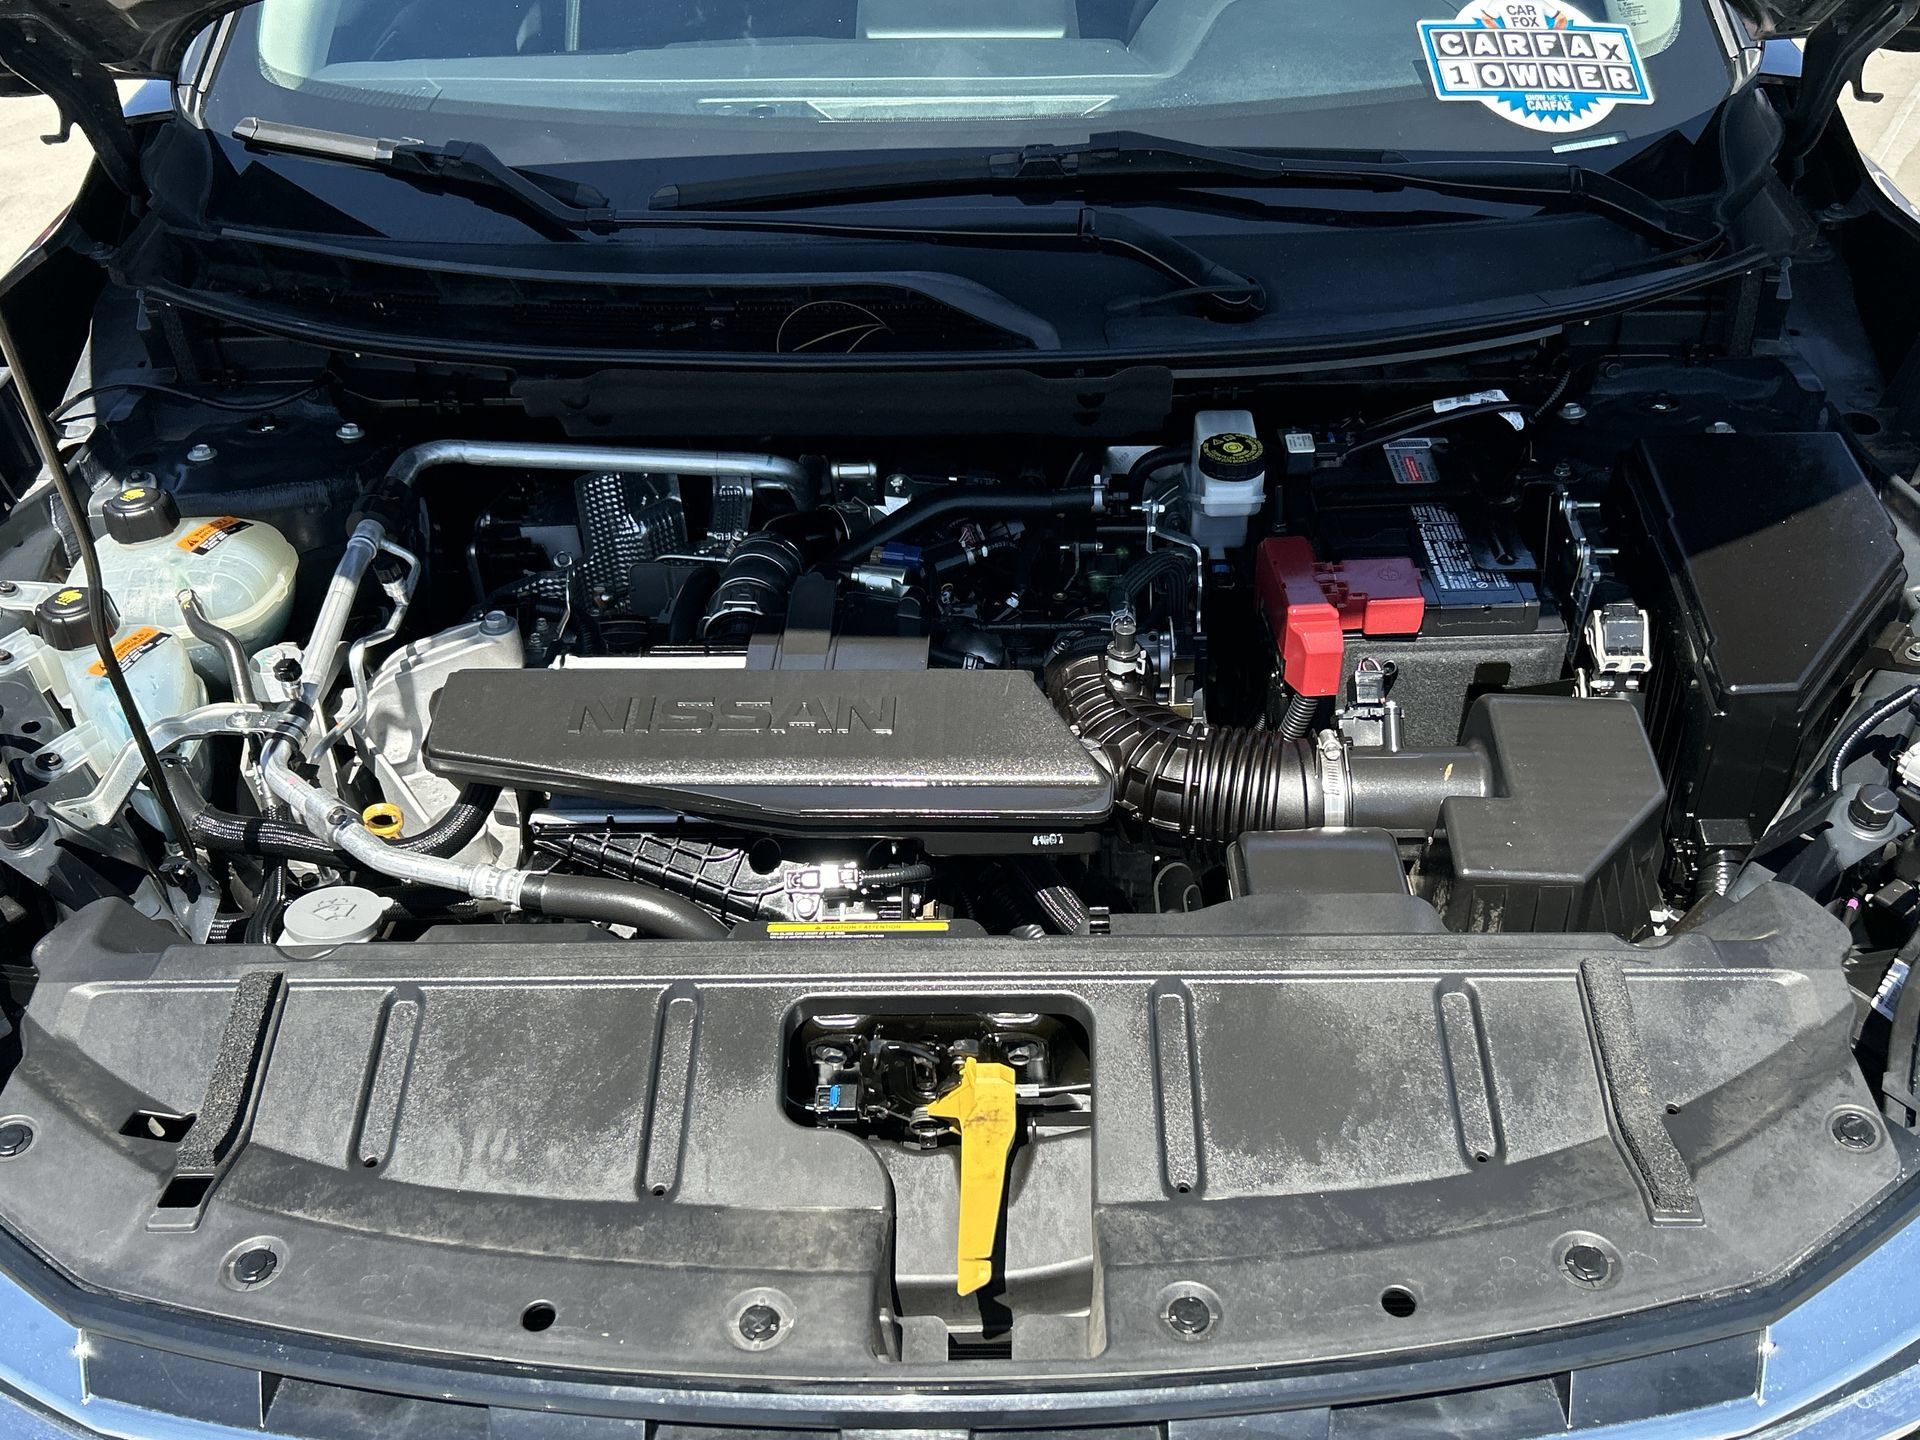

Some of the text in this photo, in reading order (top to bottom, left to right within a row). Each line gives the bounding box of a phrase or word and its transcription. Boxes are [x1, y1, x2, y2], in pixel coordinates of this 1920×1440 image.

[1506, 5, 1537, 15] CAR
[1510, 16, 1540, 28] FOX
[1439, 33, 1623, 61] CARFAX
[1449, 63, 1634, 90] 1 OWNER
[1526, 100, 1574, 111] CARFAX
[567, 697, 897, 734] NISSAN
